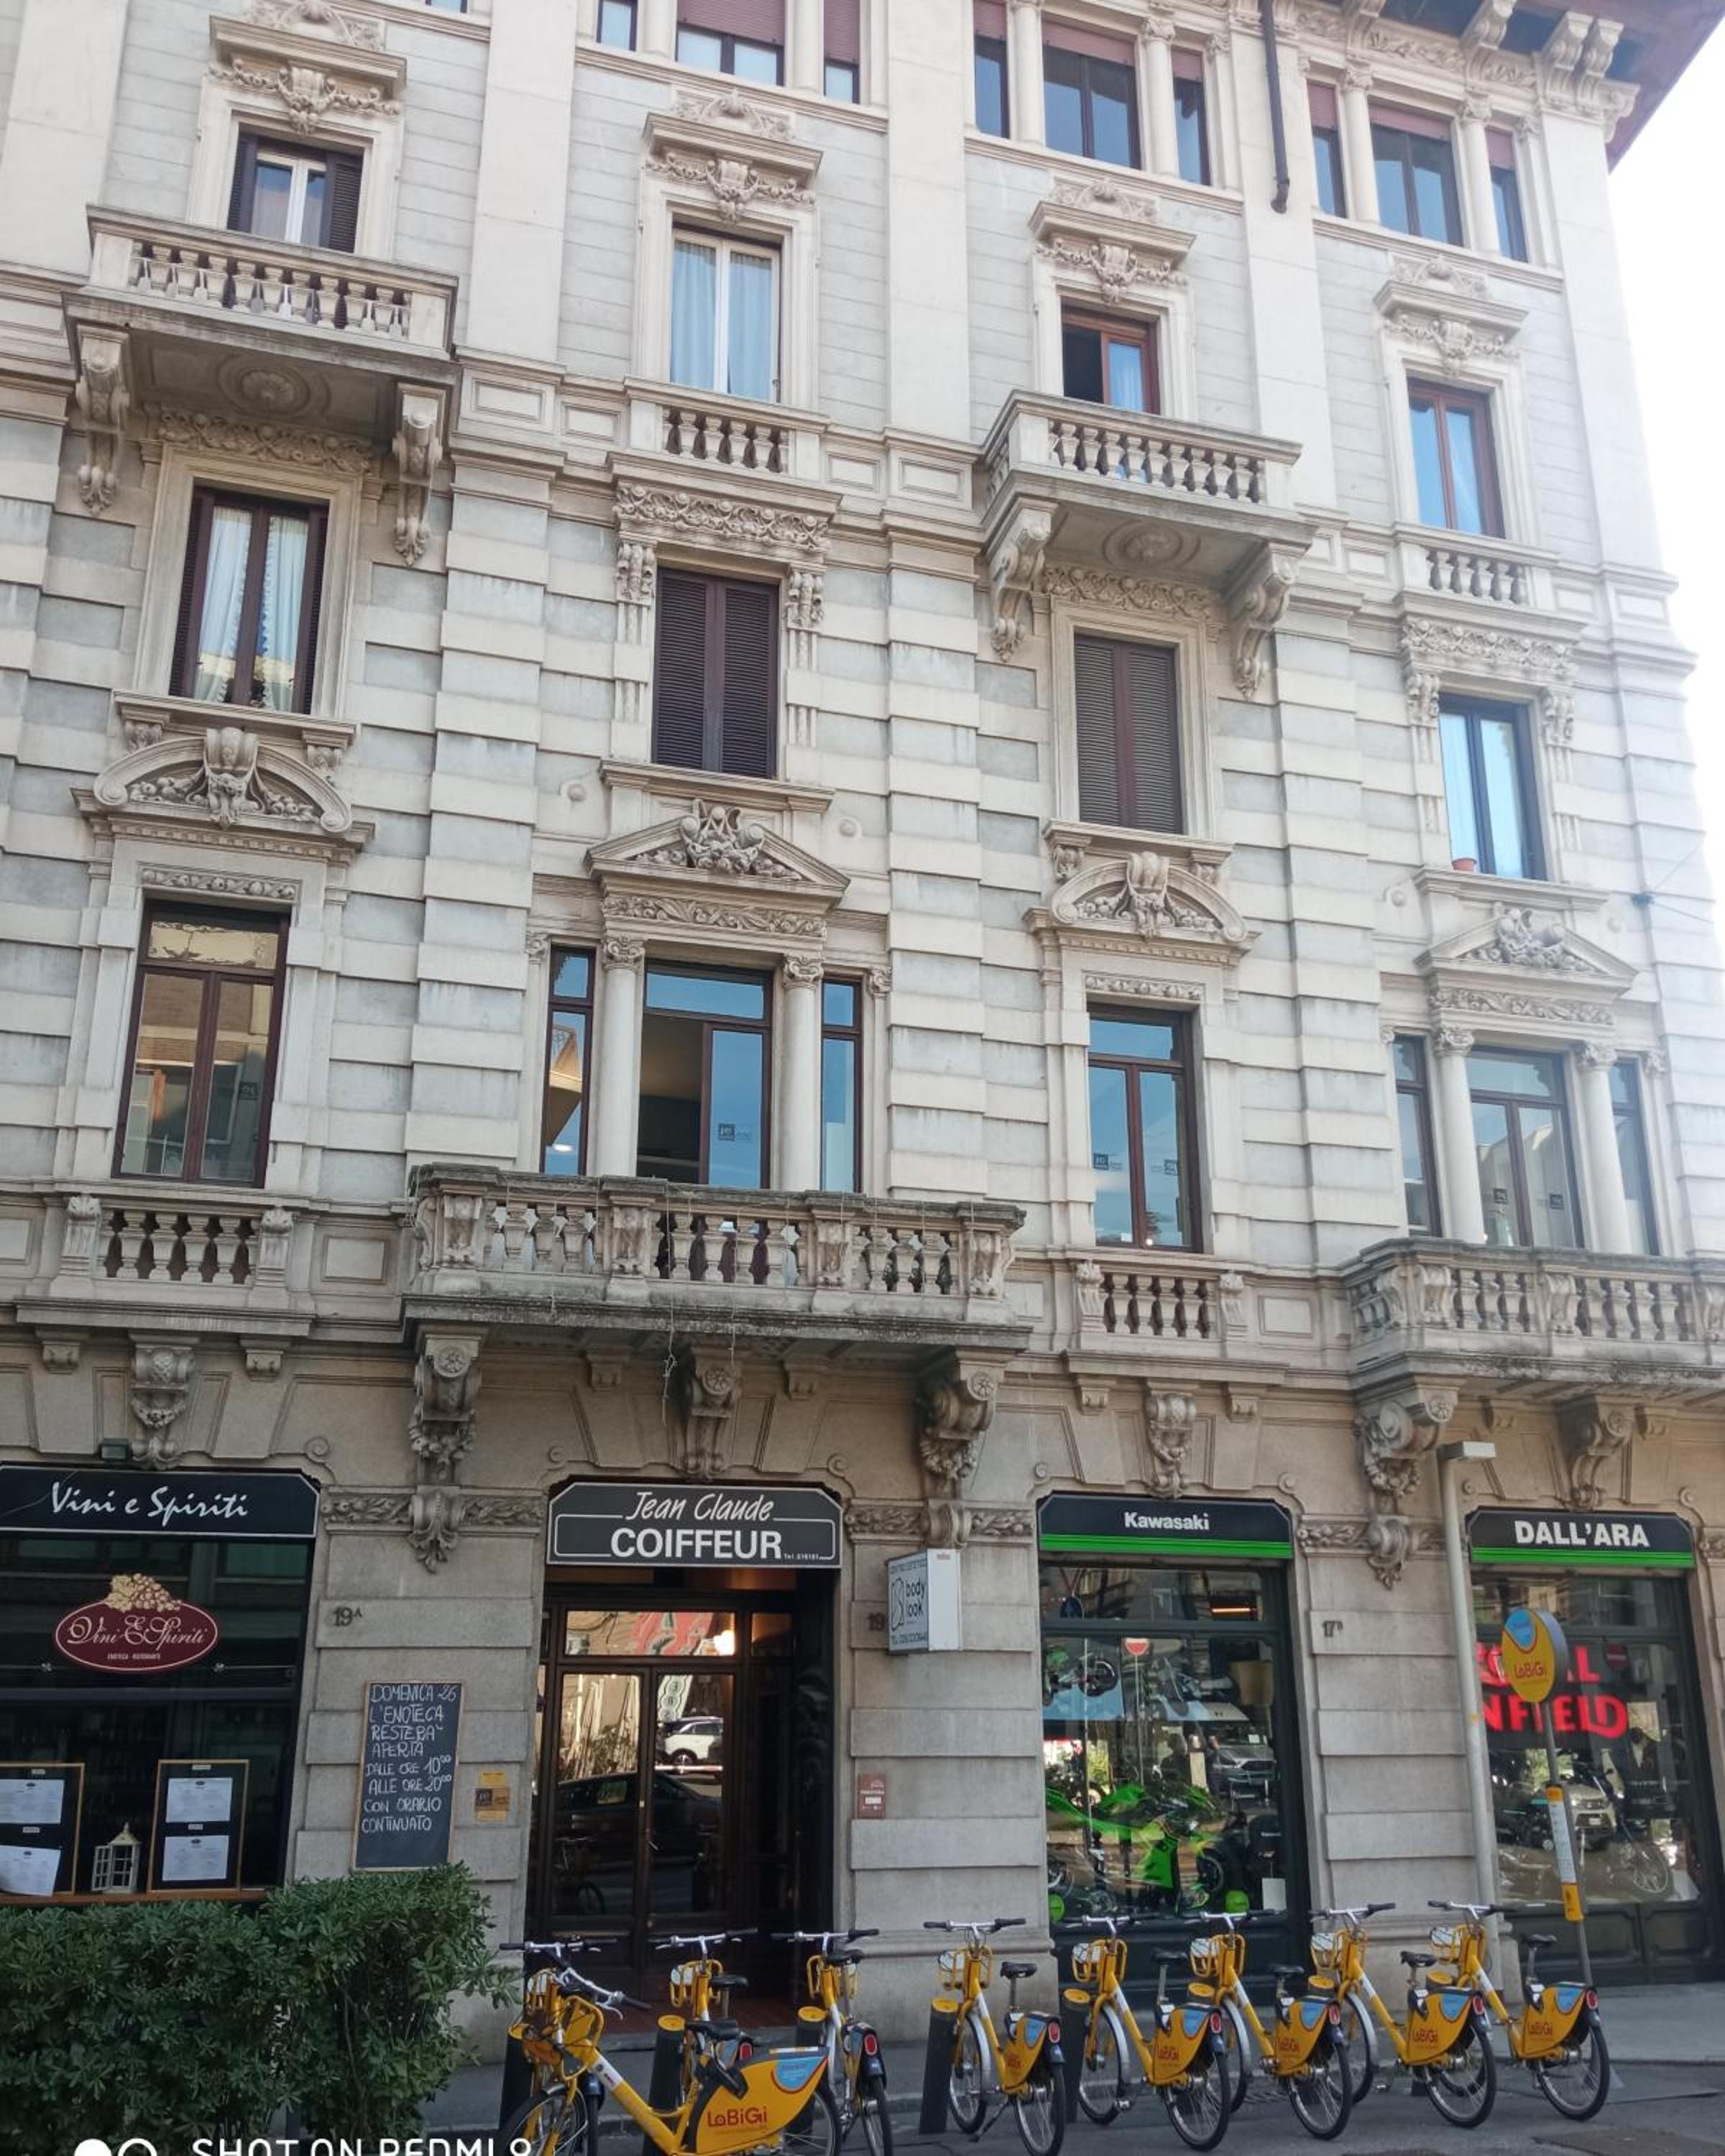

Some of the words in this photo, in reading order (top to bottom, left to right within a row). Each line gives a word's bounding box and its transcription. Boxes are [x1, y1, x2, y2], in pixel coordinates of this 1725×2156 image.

[52, 1482, 115, 1513] Vini
[125, 1498, 139, 1514] e
[147, 1486, 248, 1526] Spiriti
[625, 1491, 686, 1520] Jean
[694, 1493, 774, 1521] Claude
[1124, 1511, 1210, 1530] Kawasaki
[1514, 1520, 1650, 1547] DALL'ARA
[611, 1528, 781, 1560] COIFFEUR
[906, 1578, 925, 1599] body
[68, 1617, 120, 1644] Vini
[144, 1617, 208, 1651] Spiriti
[371, 1684, 433, 1702] DOMENICA
[369, 1704, 444, 1724] L'ENOTECA
[1483, 1694, 1629, 1740] NFIELD
[372, 1742, 424, 1759] APERTA
[365, 1763, 395, 1777] DALLE
[400, 1761, 420, 1774] ORE
[369, 1778, 397, 1795] ALLE
[402, 1779, 423, 1792] ORE
[364, 1799, 390, 1813] CON
[362, 1815, 432, 1833] CONTINUATO
[707, 2106, 767, 2127] LaBiGi
